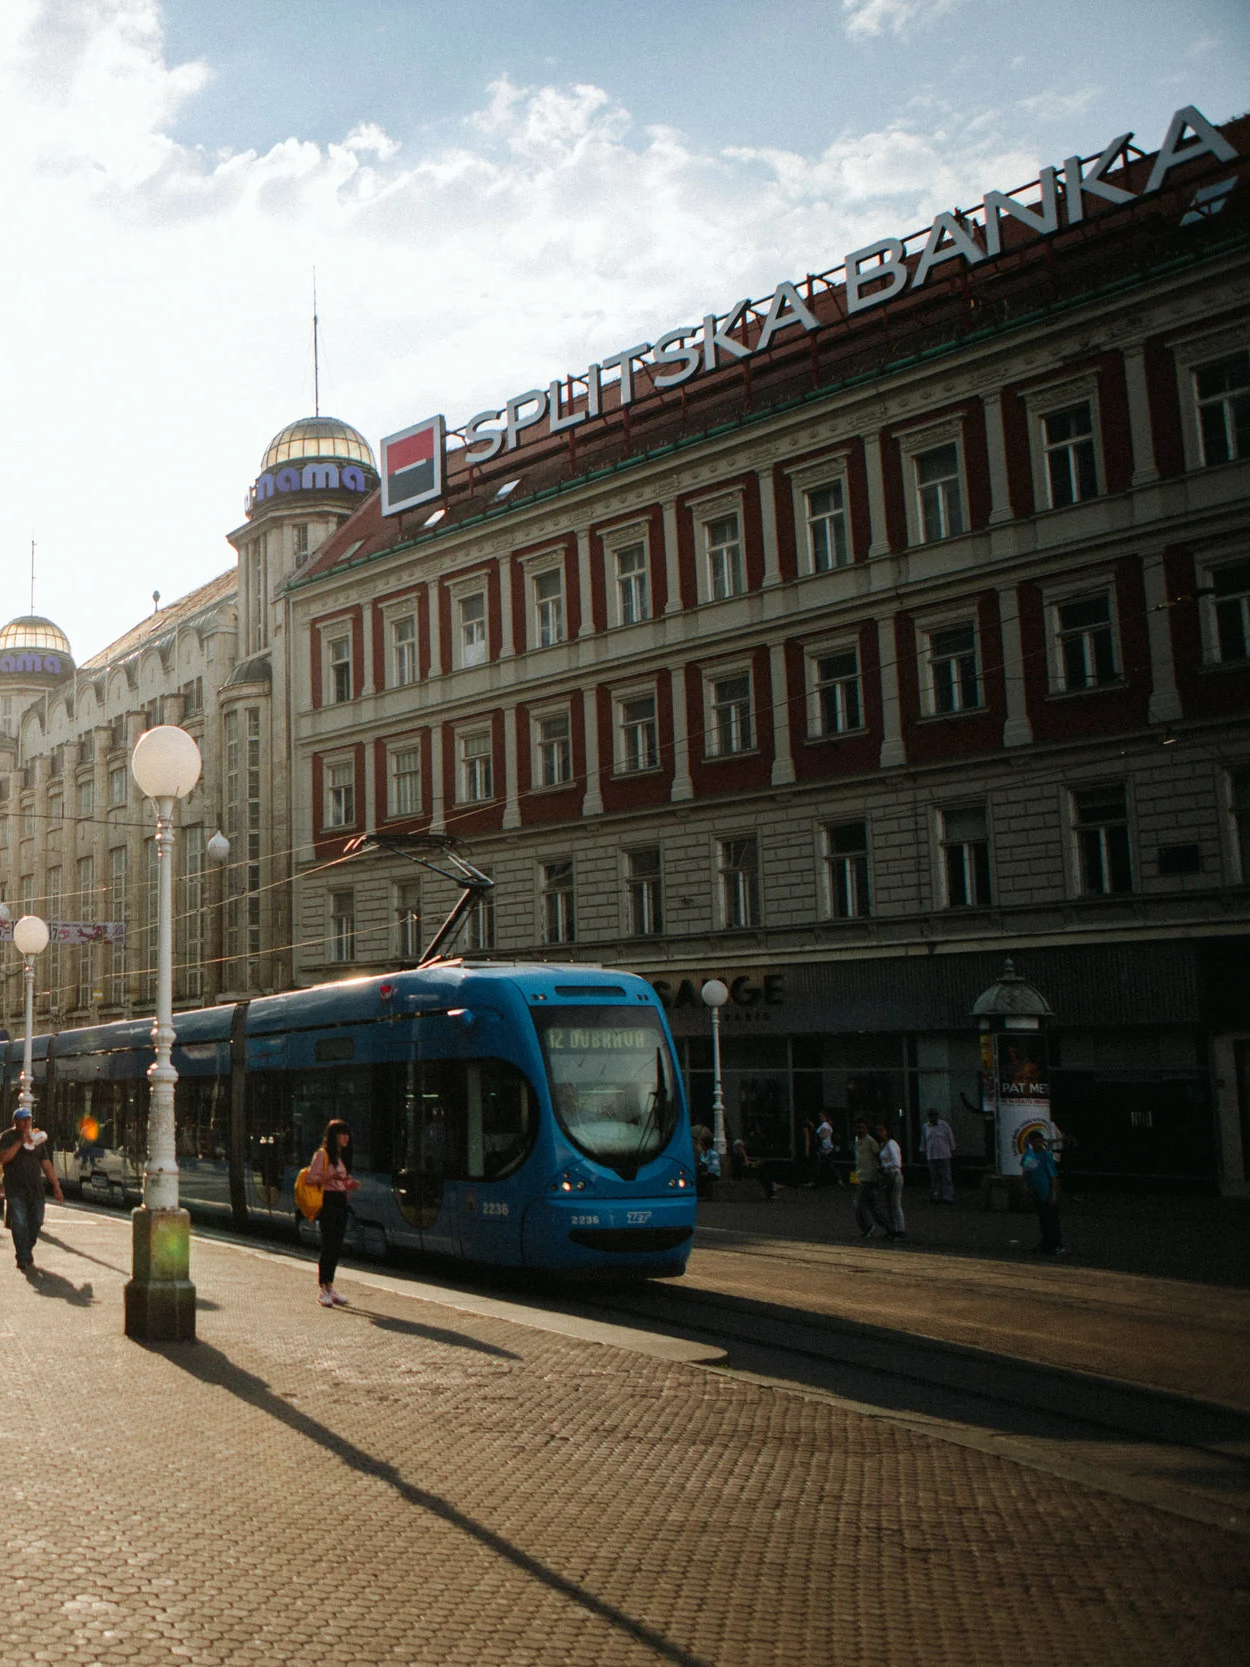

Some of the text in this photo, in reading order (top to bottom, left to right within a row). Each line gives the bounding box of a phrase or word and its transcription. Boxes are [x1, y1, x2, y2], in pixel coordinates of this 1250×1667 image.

[465, 105, 1239, 463] SPLITSKA BANKA
[257, 463, 365, 501] nama
[550, 1029, 645, 1049] 12 DUBRAVA
[1002, 1082, 1026, 1094] PAT
[483, 1201, 509, 1217] 2236
[571, 1215, 600, 1225] 2236
